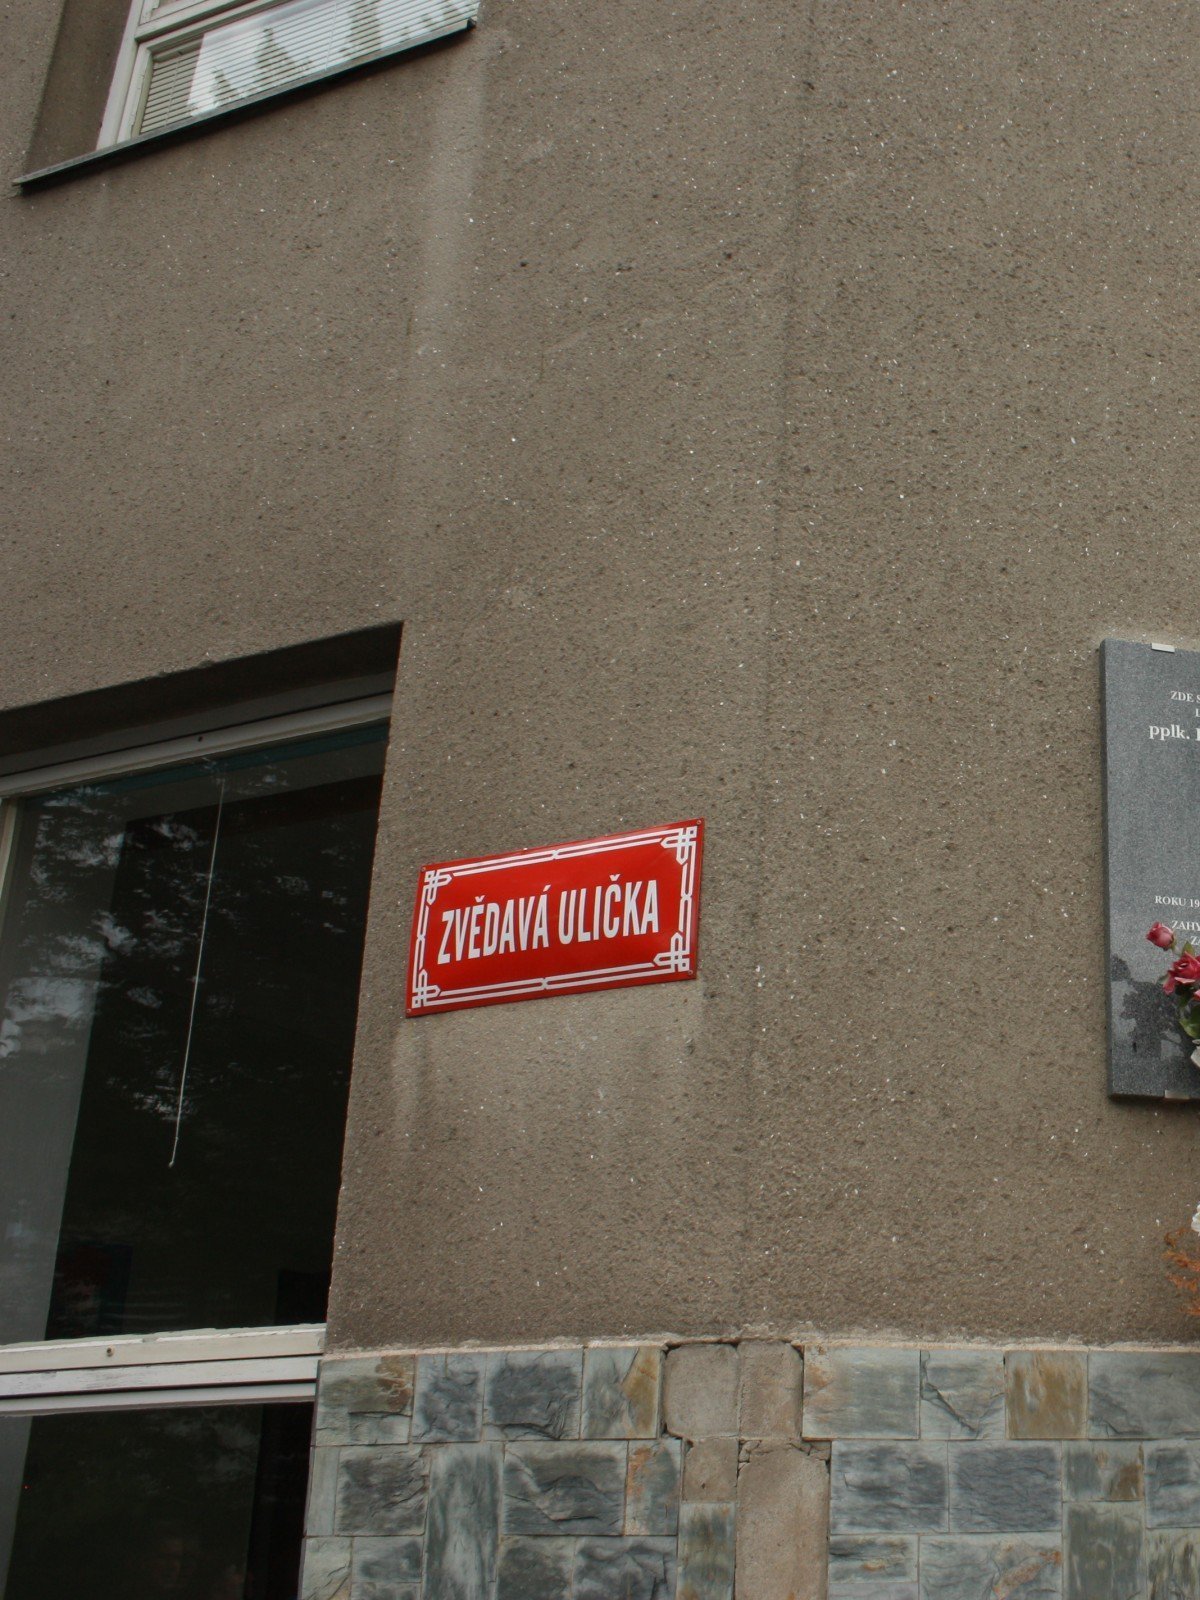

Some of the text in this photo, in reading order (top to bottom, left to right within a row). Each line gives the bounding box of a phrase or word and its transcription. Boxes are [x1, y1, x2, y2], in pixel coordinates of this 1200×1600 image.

[1170, 690, 1194, 703] ZDE
[1149, 724, 1190, 741] pplk.
[1155, 895, 1187, 907] ROKU
[437, 873, 659, 965] ZVĚDAVÁ ULIČKA
